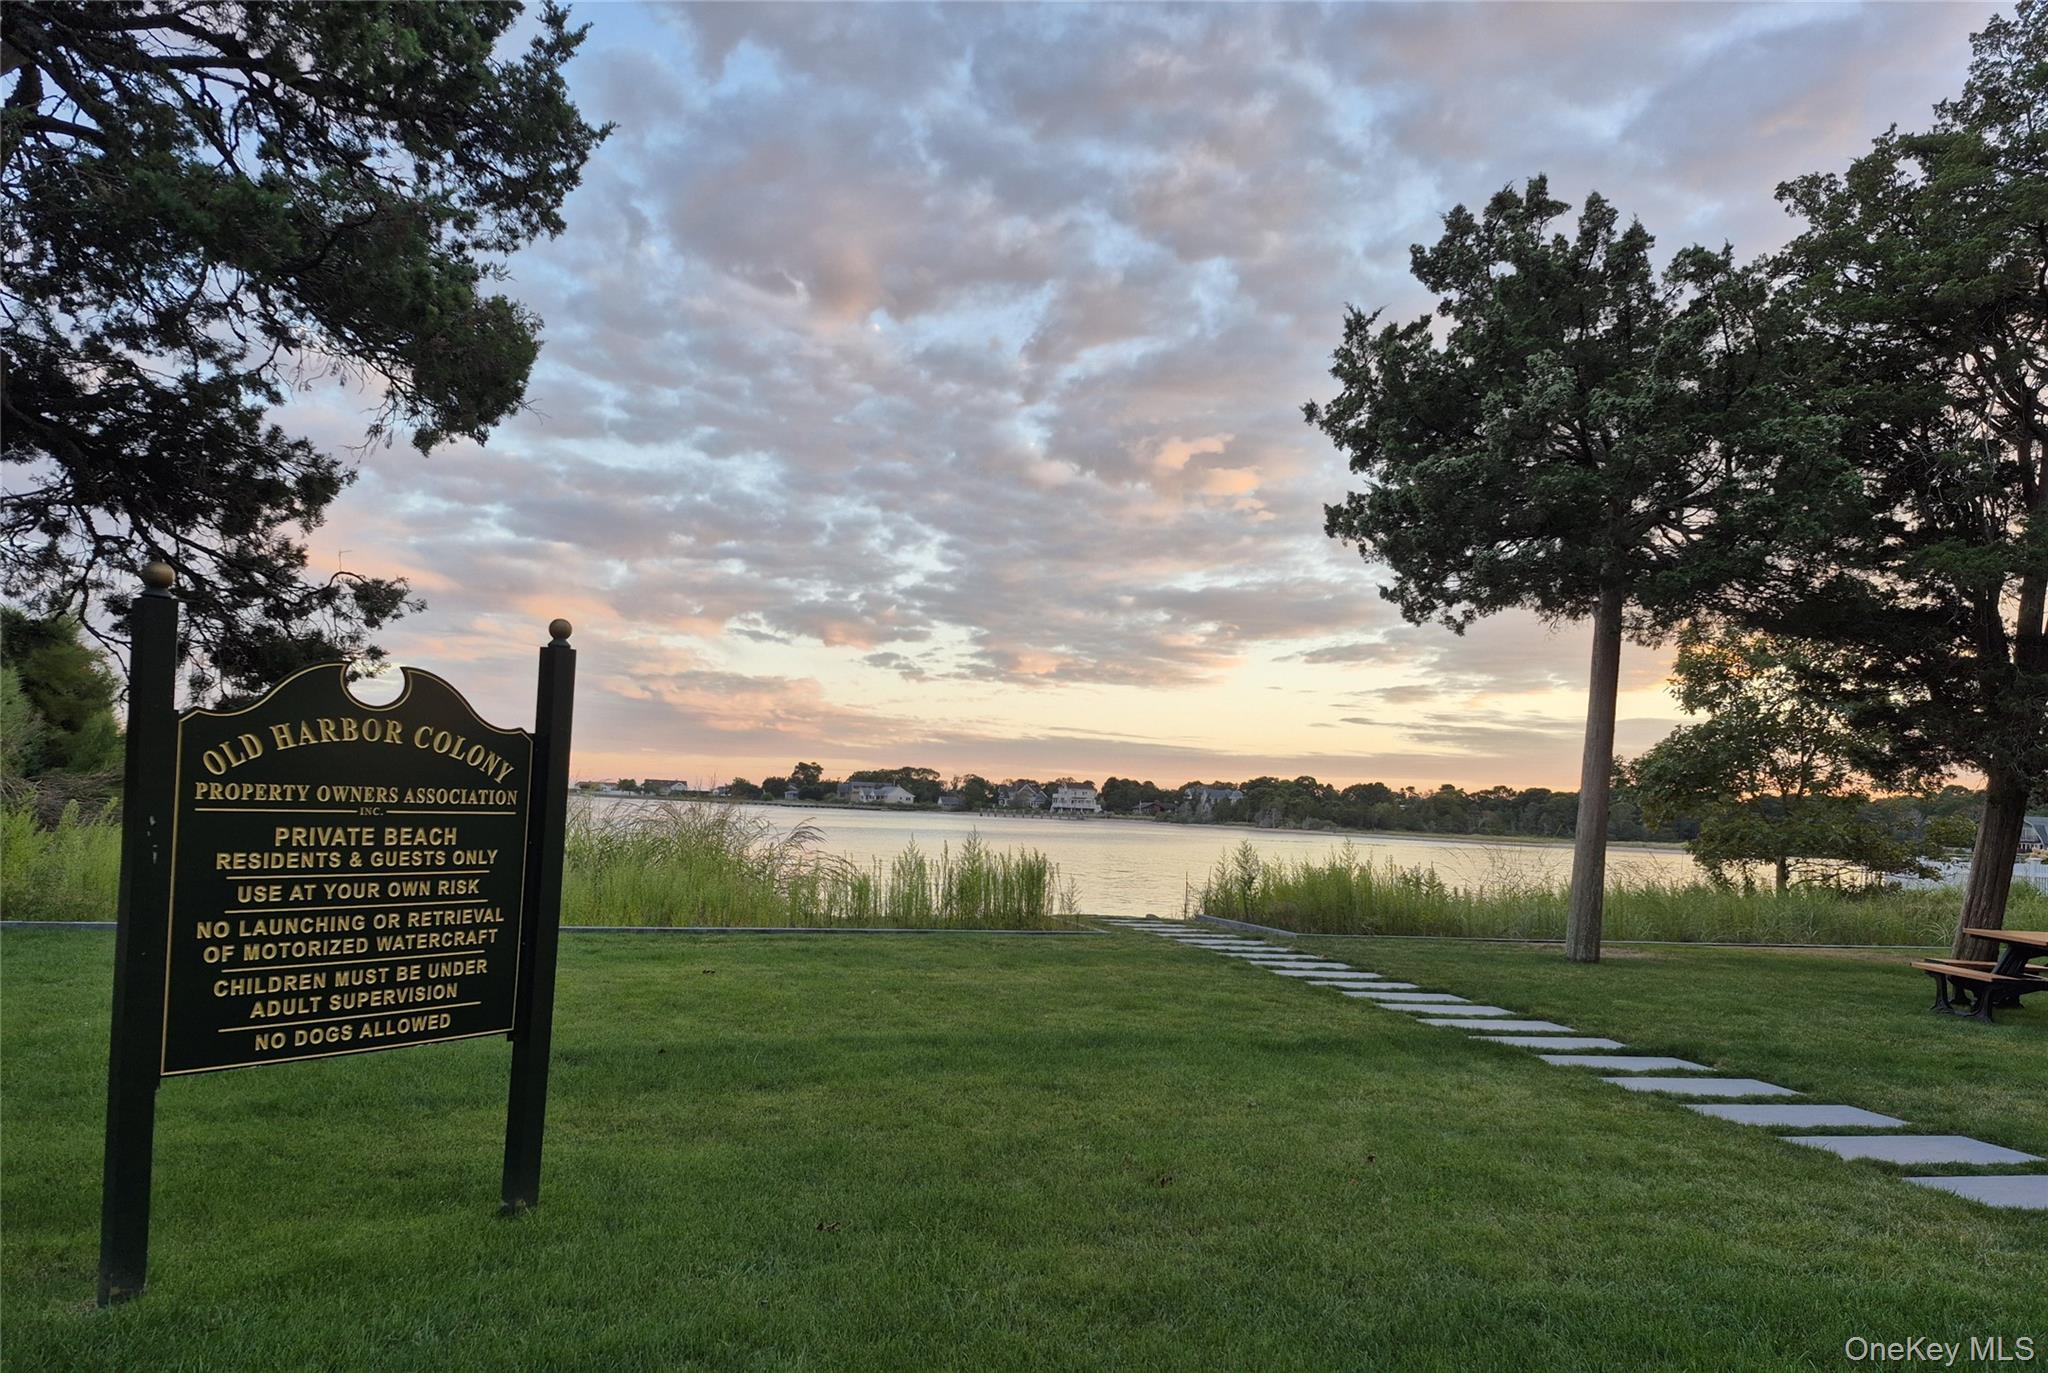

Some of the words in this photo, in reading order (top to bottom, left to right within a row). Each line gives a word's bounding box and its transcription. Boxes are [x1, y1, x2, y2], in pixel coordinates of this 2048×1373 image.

[203, 733, 264, 775] OLD
[270, 717, 403, 751] HARBOR
[414, 725, 515, 784] COLONY
[195, 782, 311, 801] PROPERTY
[317, 785, 399, 803] OWNERS
[404, 788, 518, 805] ASSOCIATION
[360, 807, 384, 816] INC.
[274, 827, 375, 847] PRIVATE
[384, 827, 457, 845] BEACH
[216, 852, 341, 870] RESIDENTS
[349, 852, 363, 867] &
[371, 851, 446, 866] GUESTS
[452, 849, 498, 865] ONLY
[237, 885, 282, 903] USE
[289, 884, 317, 900] AT
[326, 882, 380, 900] YOUR
[388, 881, 431, 897] OWN
[438, 879, 480, 895] RISK
[197, 920, 230, 939] NO
[239, 914, 365, 937] LAUNCHING
[373, 913, 401, 929] OR
[408, 907, 504, 927] RETRIEVAL
[203, 945, 234, 964] OF
[243, 937, 369, 962] MOTORIZED
[376, 929, 498, 952] WATERCRAFT
[213, 972, 326, 997] CHILDREN
[335, 968, 390, 987] MUST
[396, 965, 421, 981] BE
[428, 959, 488, 978] UNDER
[250, 996, 322, 1018] ADULT
[329, 983, 458, 1011] SUPERVISION
[255, 1032, 286, 1051] NO
[295, 1024, 353, 1047] DOGS
[360, 1013, 451, 1039] ALLOWED
